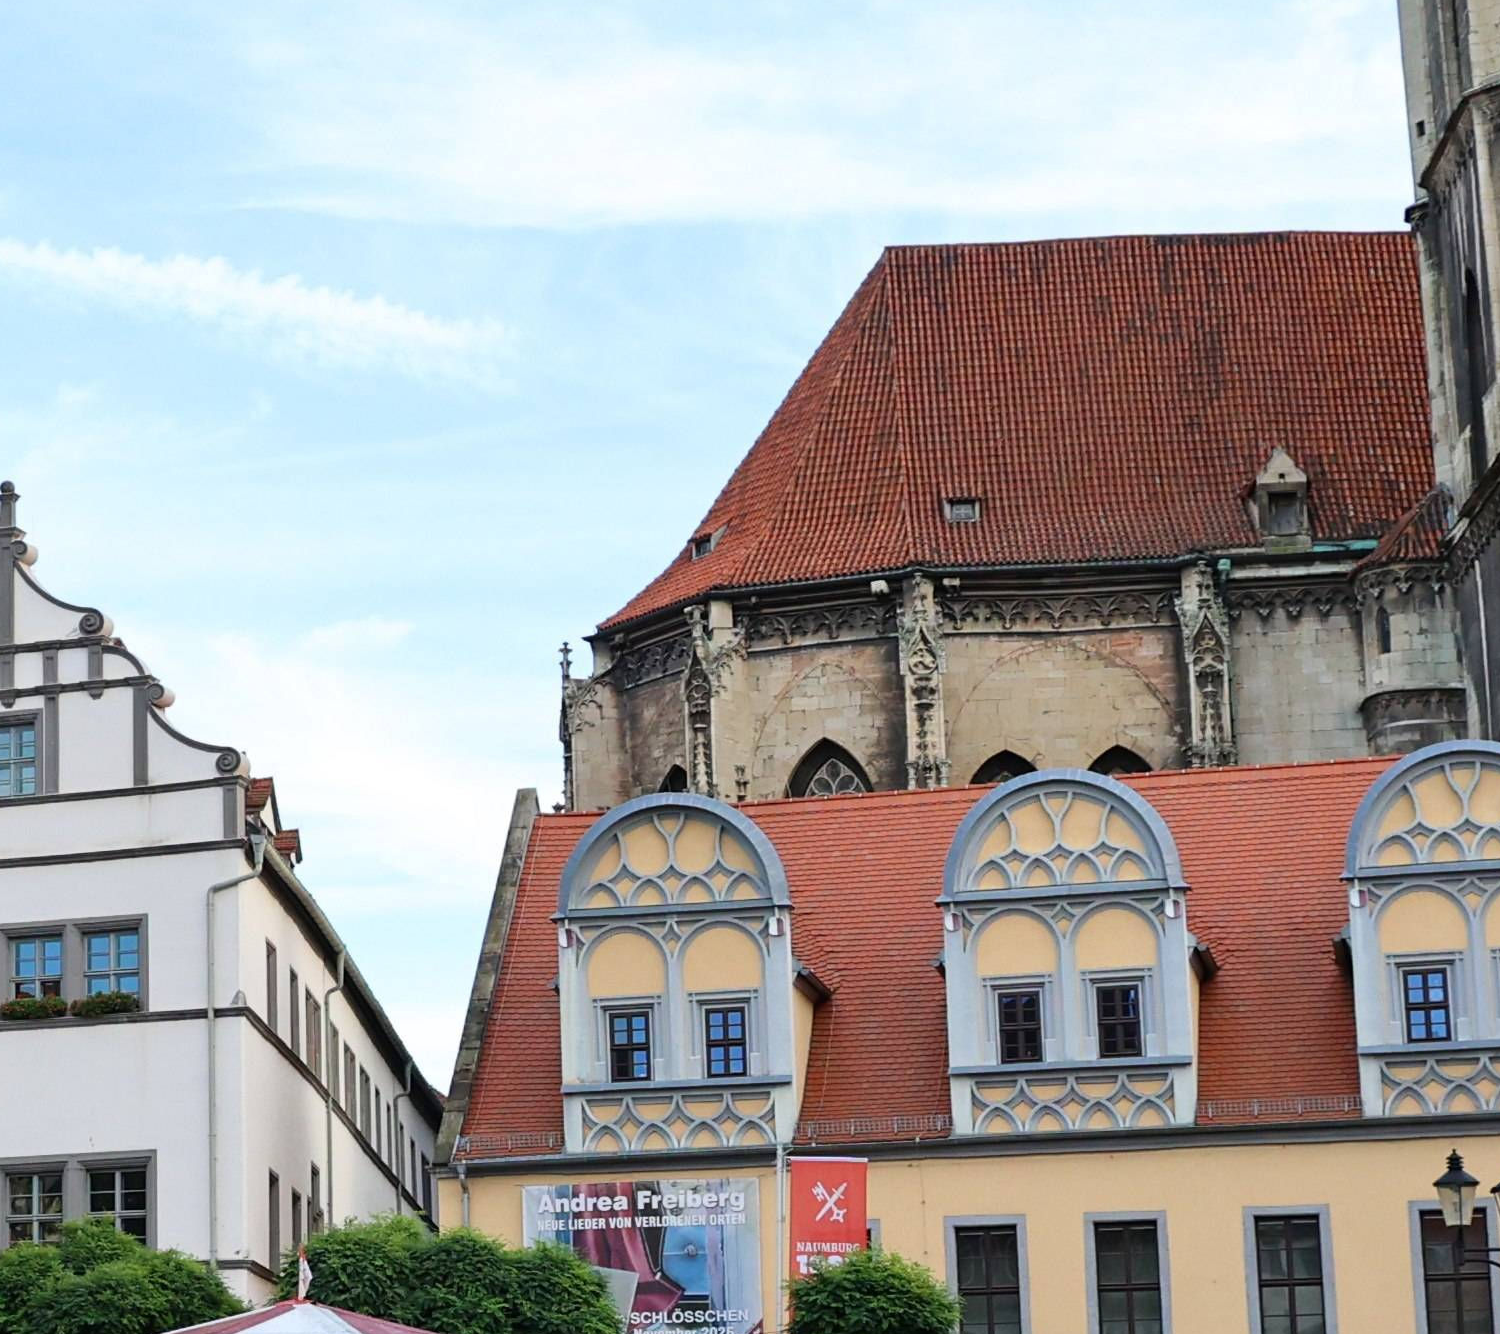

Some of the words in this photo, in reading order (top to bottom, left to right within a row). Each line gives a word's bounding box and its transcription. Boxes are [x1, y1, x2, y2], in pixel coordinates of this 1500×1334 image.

[538, 1194, 628, 1214] Andrea
[637, 1190, 745, 1212] Freiberg
[537, 1219, 566, 1232] NEUE
[568, 1217, 606, 1230] LIEDER
[609, 1216, 632, 1229] VON
[634, 1214, 706, 1228] VERLORENEN
[709, 1212, 747, 1226] ORTEN
[795, 1241, 861, 1253] NAUMBURG
[630, 1307, 750, 1324] SCHLÖSSCHEN
